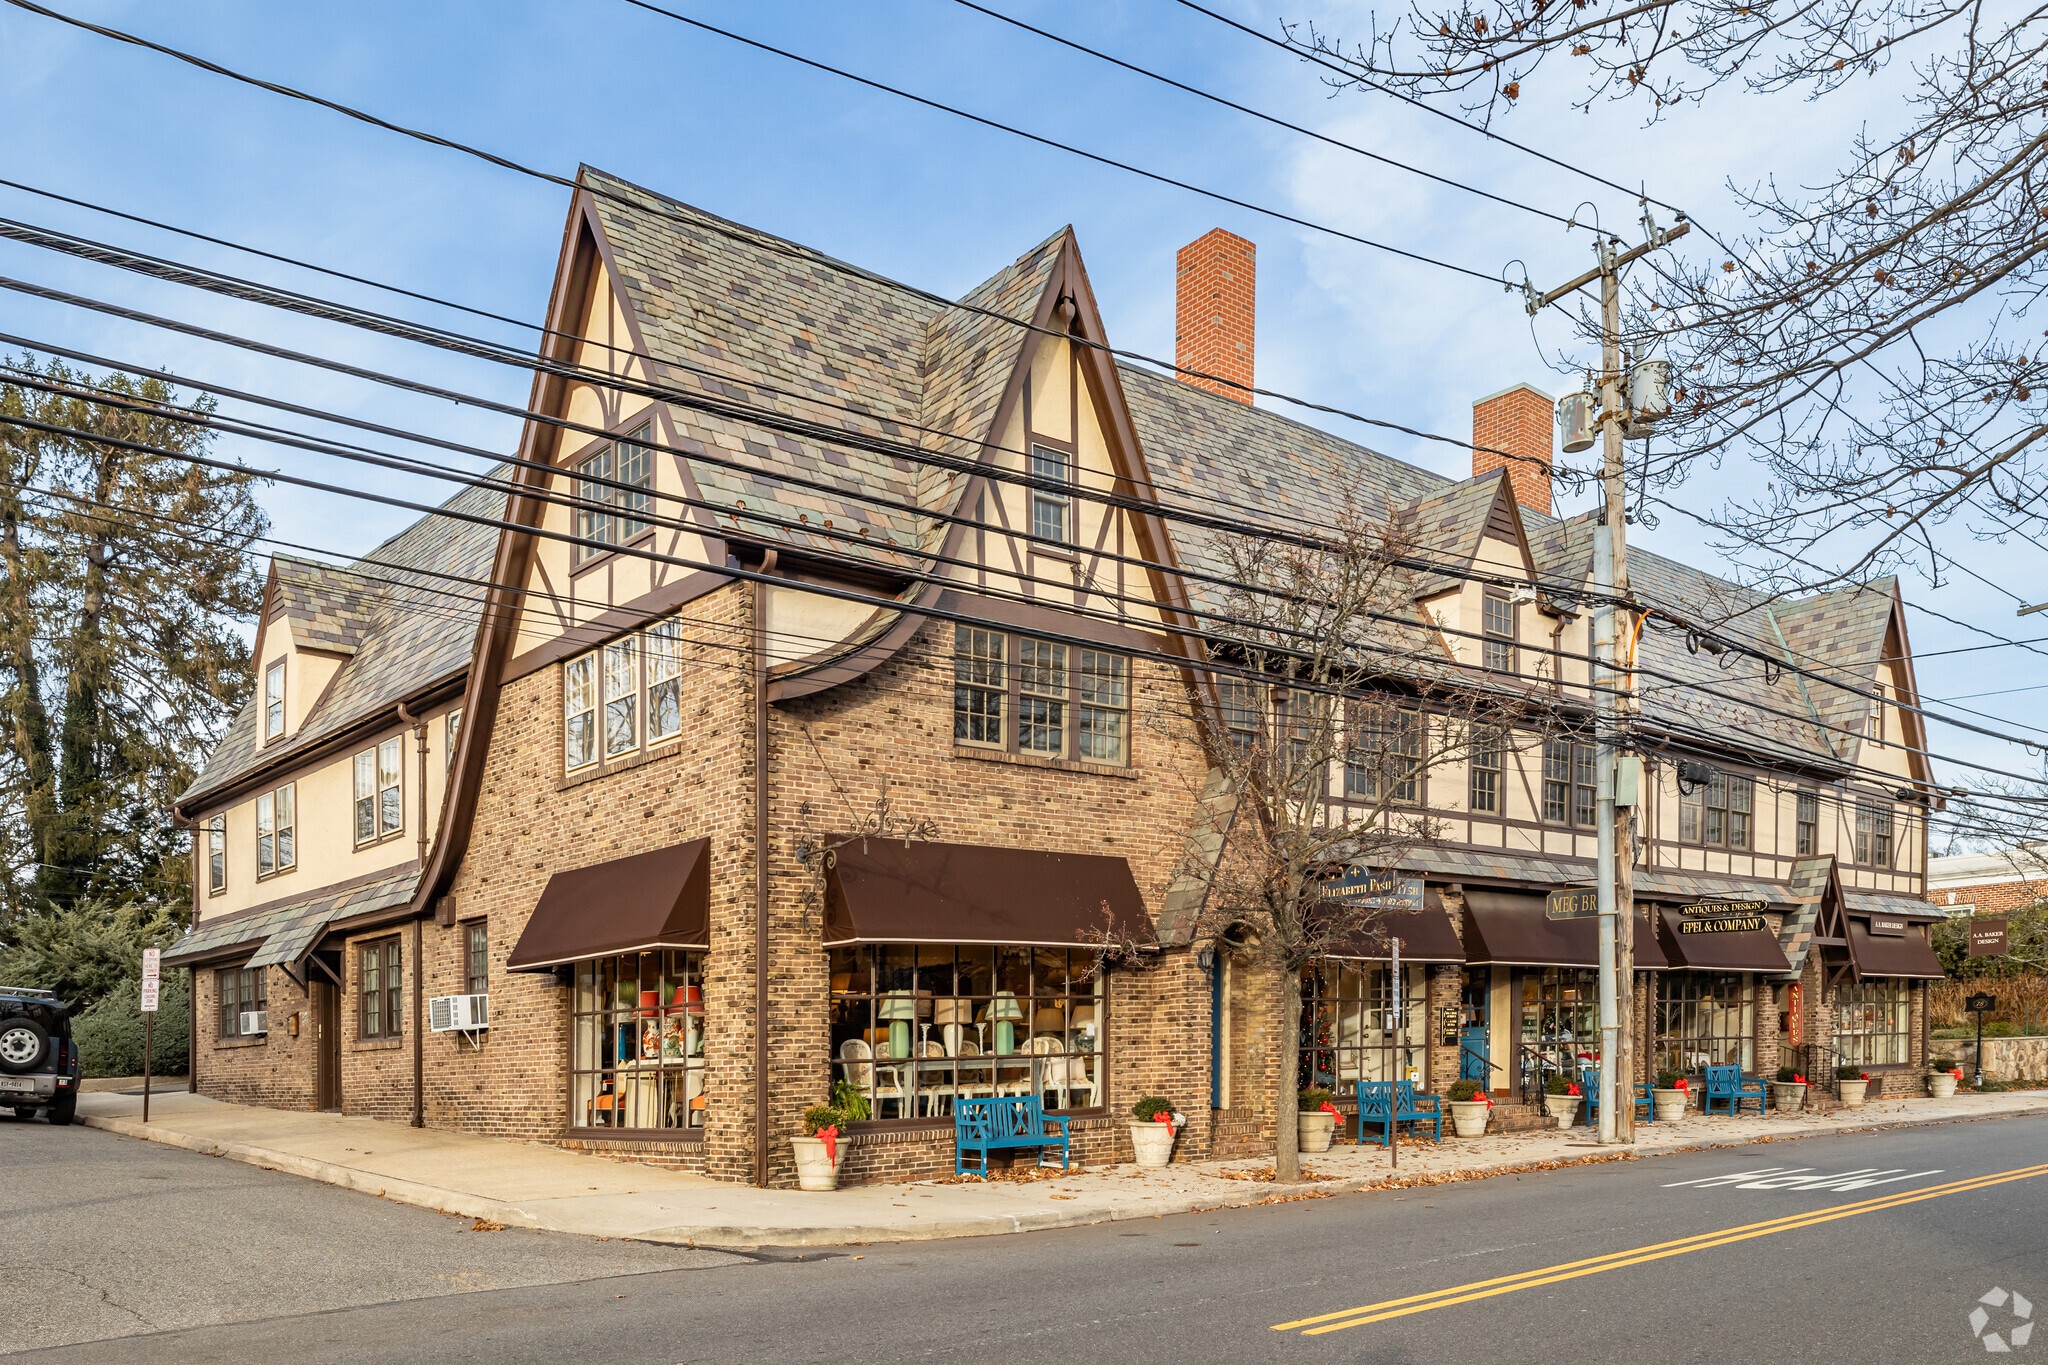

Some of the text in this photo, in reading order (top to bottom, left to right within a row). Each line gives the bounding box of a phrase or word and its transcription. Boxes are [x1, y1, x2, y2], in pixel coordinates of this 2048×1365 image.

[1322, 878, 1391, 898] ELIZABETH PASH
[1552, 894, 1597, 913] MEG BR
[1682, 904, 1722, 915] ANTIQUES
[1722, 903, 1730, 912] &
[1731, 901, 1761, 911] DESIGN
[1682, 918, 1760, 933] EPEL & COMPANY
